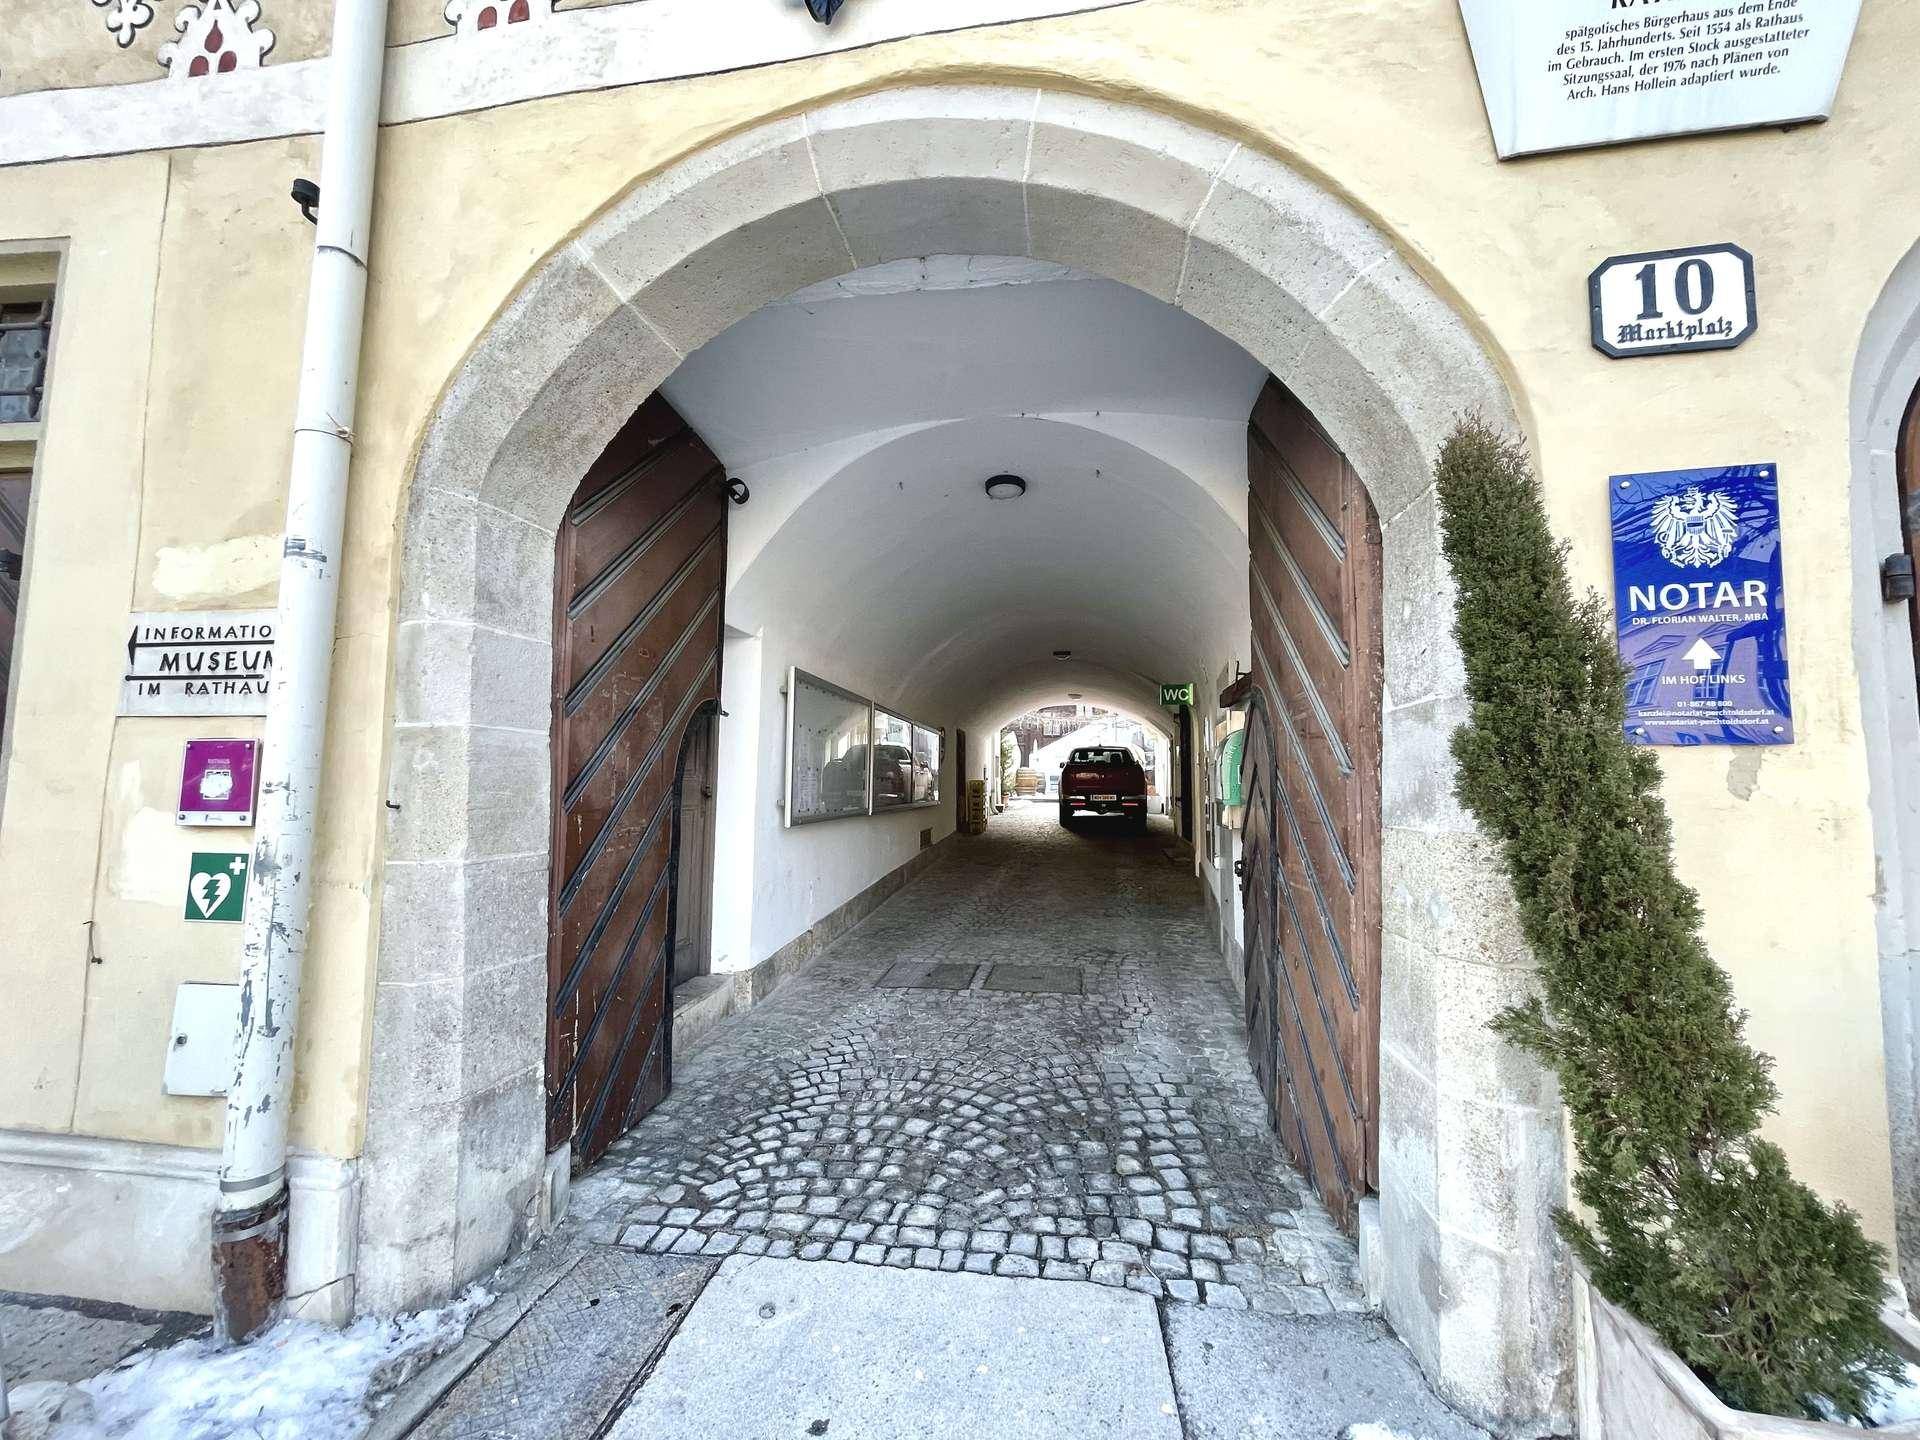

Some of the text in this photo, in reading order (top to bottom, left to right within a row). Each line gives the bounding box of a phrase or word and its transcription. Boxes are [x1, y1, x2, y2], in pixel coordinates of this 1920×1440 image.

[1556, 13, 1804, 56] des 15. Jahrhunderts. Seit 1554 als Rathaus
[1565, 0, 1797, 41] spätgotisches Bürgerhaus aus dem Ende
[1547, 28, 1811, 73] im Gebrauch. Im ersten Stock ausgestatteter
[1563, 48, 1790, 86] Sitzungssaal, der 1976 nach Plänen von
[1567, 62, 1781, 101] Arch. Hans Hollein adaptiert wurde.
[1635, 258, 1714, 320] 10
[1617, 316, 1733, 344] Marktplatz
[1629, 580, 1769, 612] NOTAR
[145, 624, 272, 640] INFORMATIO
[1632, 617, 1650, 626] DR.
[1652, 615, 1697, 625] FLORIAN
[1744, 612, 1769, 622] MBA
[138, 680, 270, 696] IM RATHAU
[1163, 687, 1190, 702] WC
[1661, 673, 1746, 685] IM HOF LINKS
